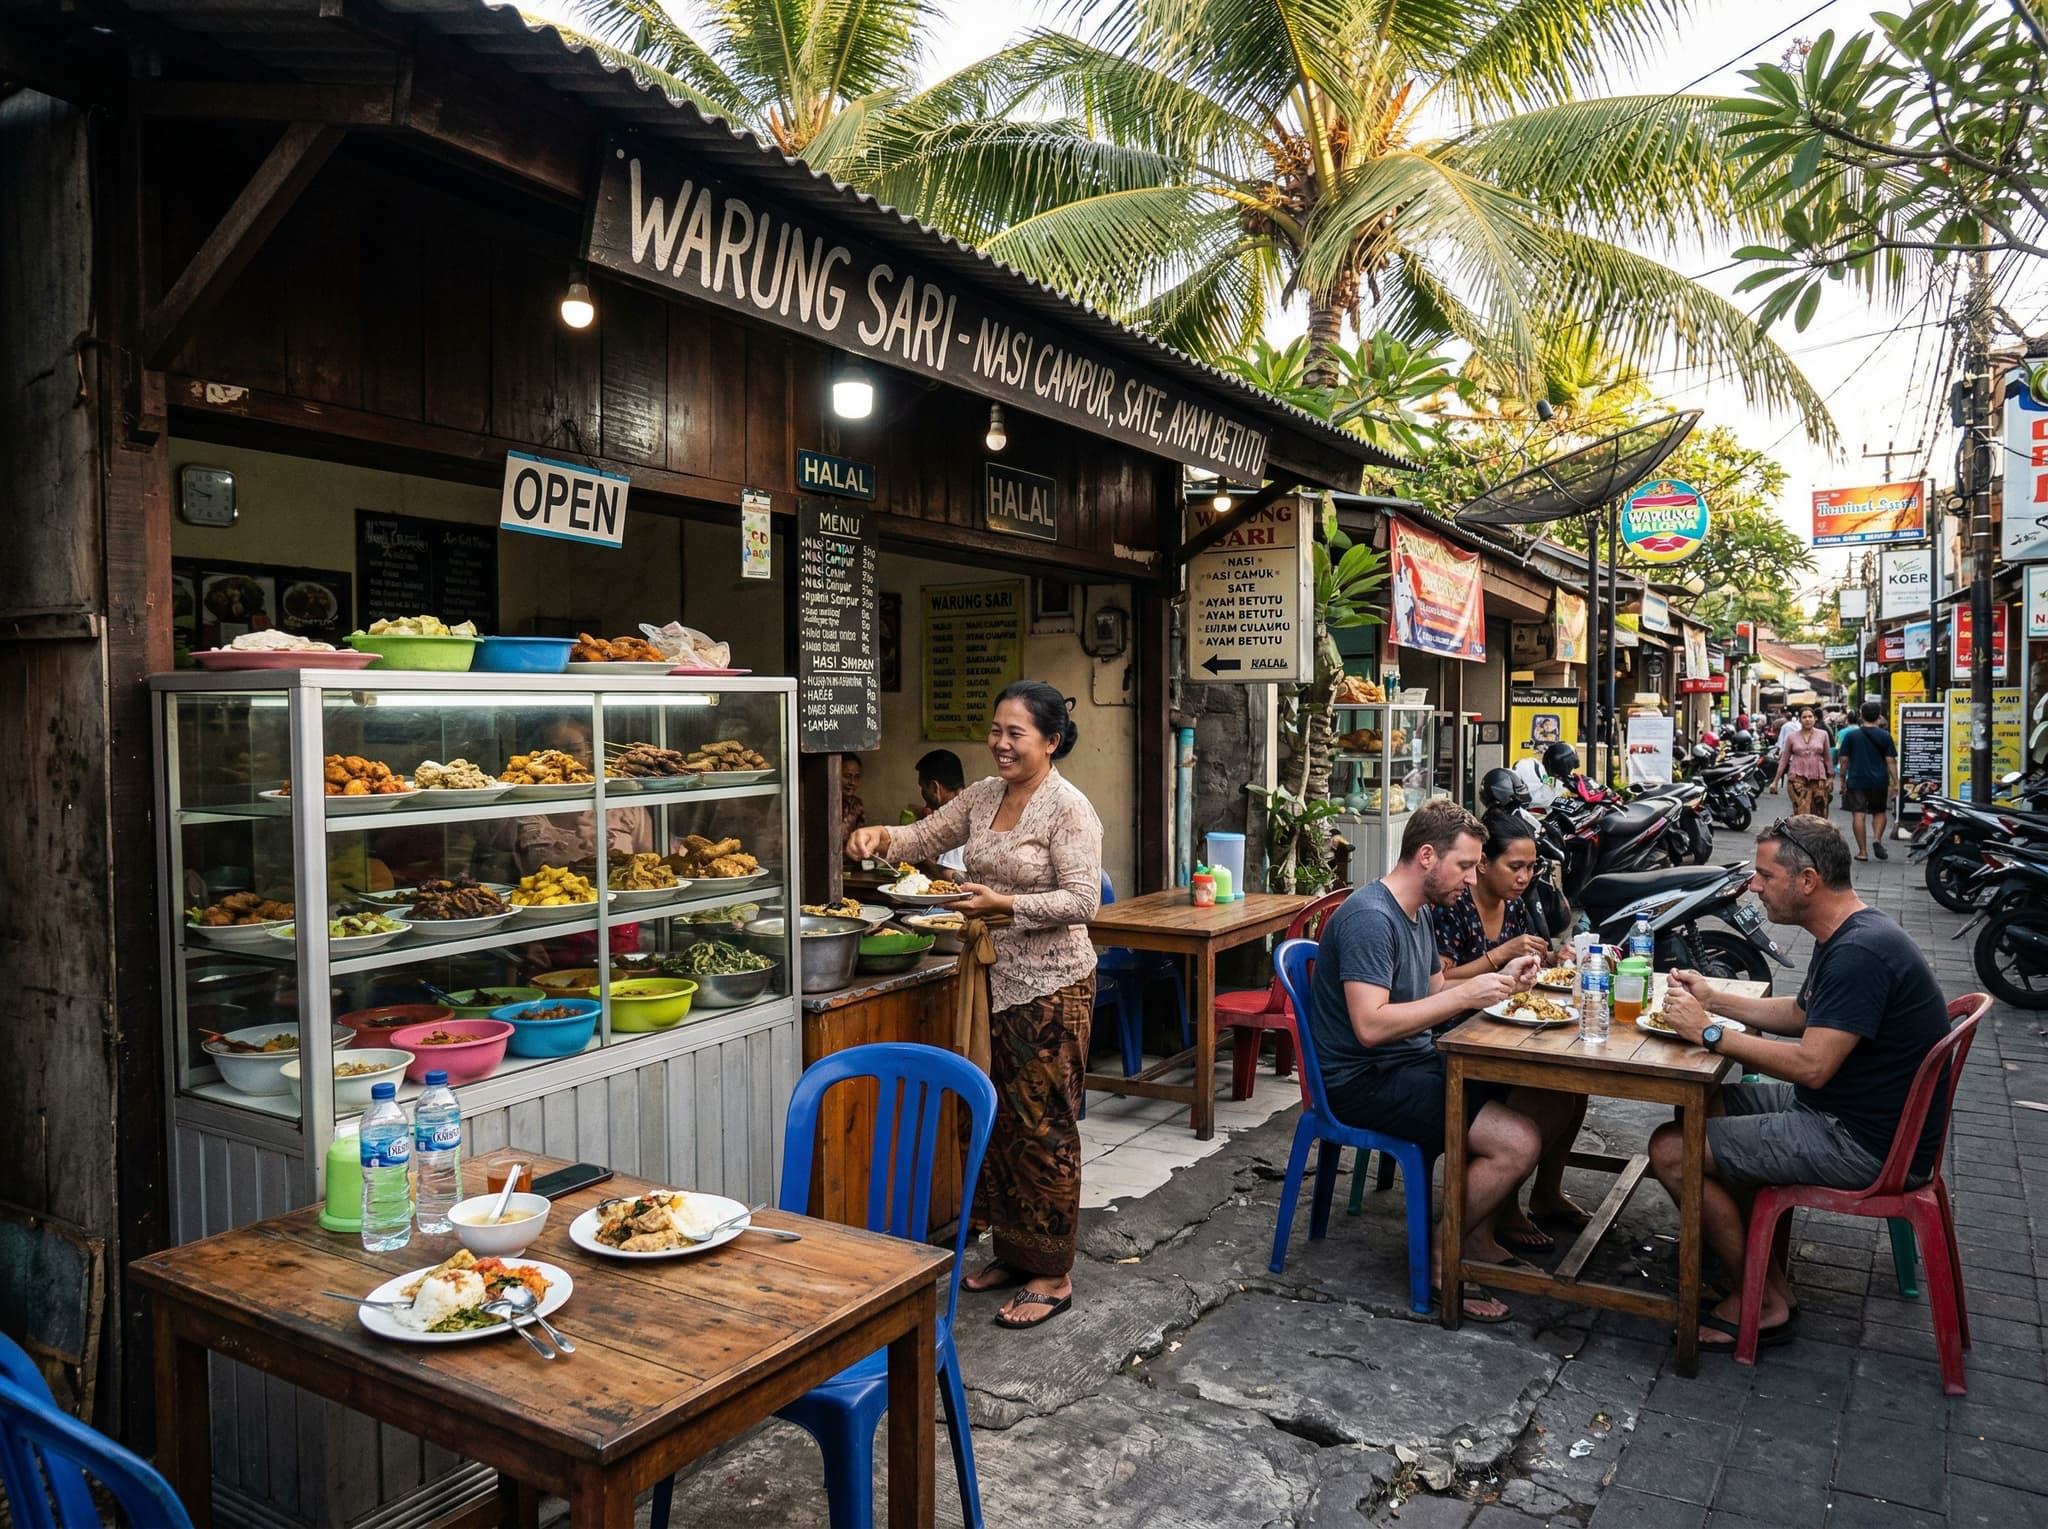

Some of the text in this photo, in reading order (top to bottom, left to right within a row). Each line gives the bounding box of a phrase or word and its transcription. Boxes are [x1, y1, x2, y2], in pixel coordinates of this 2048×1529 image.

[630, 158, 851, 330] WARUNG
[858, 264, 957, 371] SARI
[973, 317, 1033, 389] NASI
[1034, 344, 1115, 428] CAMPUR,
[1118, 379, 1167, 446] SATE,
[1165, 400, 1213, 456] AYAM
[1209, 416, 1267, 476] BETUTU
[804, 457, 869, 493] HALAL
[513, 467, 619, 535] OPEN
[989, 476, 1054, 527] HALAL
[819, 512, 860, 535] MENU
[1195, 506, 1292, 527] WUNG
[1228, 556, 1254, 567] NASI
[1889, 573, 1928, 584] KOER
[1228, 583, 1255, 593] SATE
[931, 592, 1012, 610] WARUNG SARI
[1206, 595, 1283, 607] AYAM BETUTU
[1206, 609, 1283, 620] AYAM BETUTU
[1206, 635, 1283, 646] AYAM BETUTU
[813, 656, 837, 669] HASI
